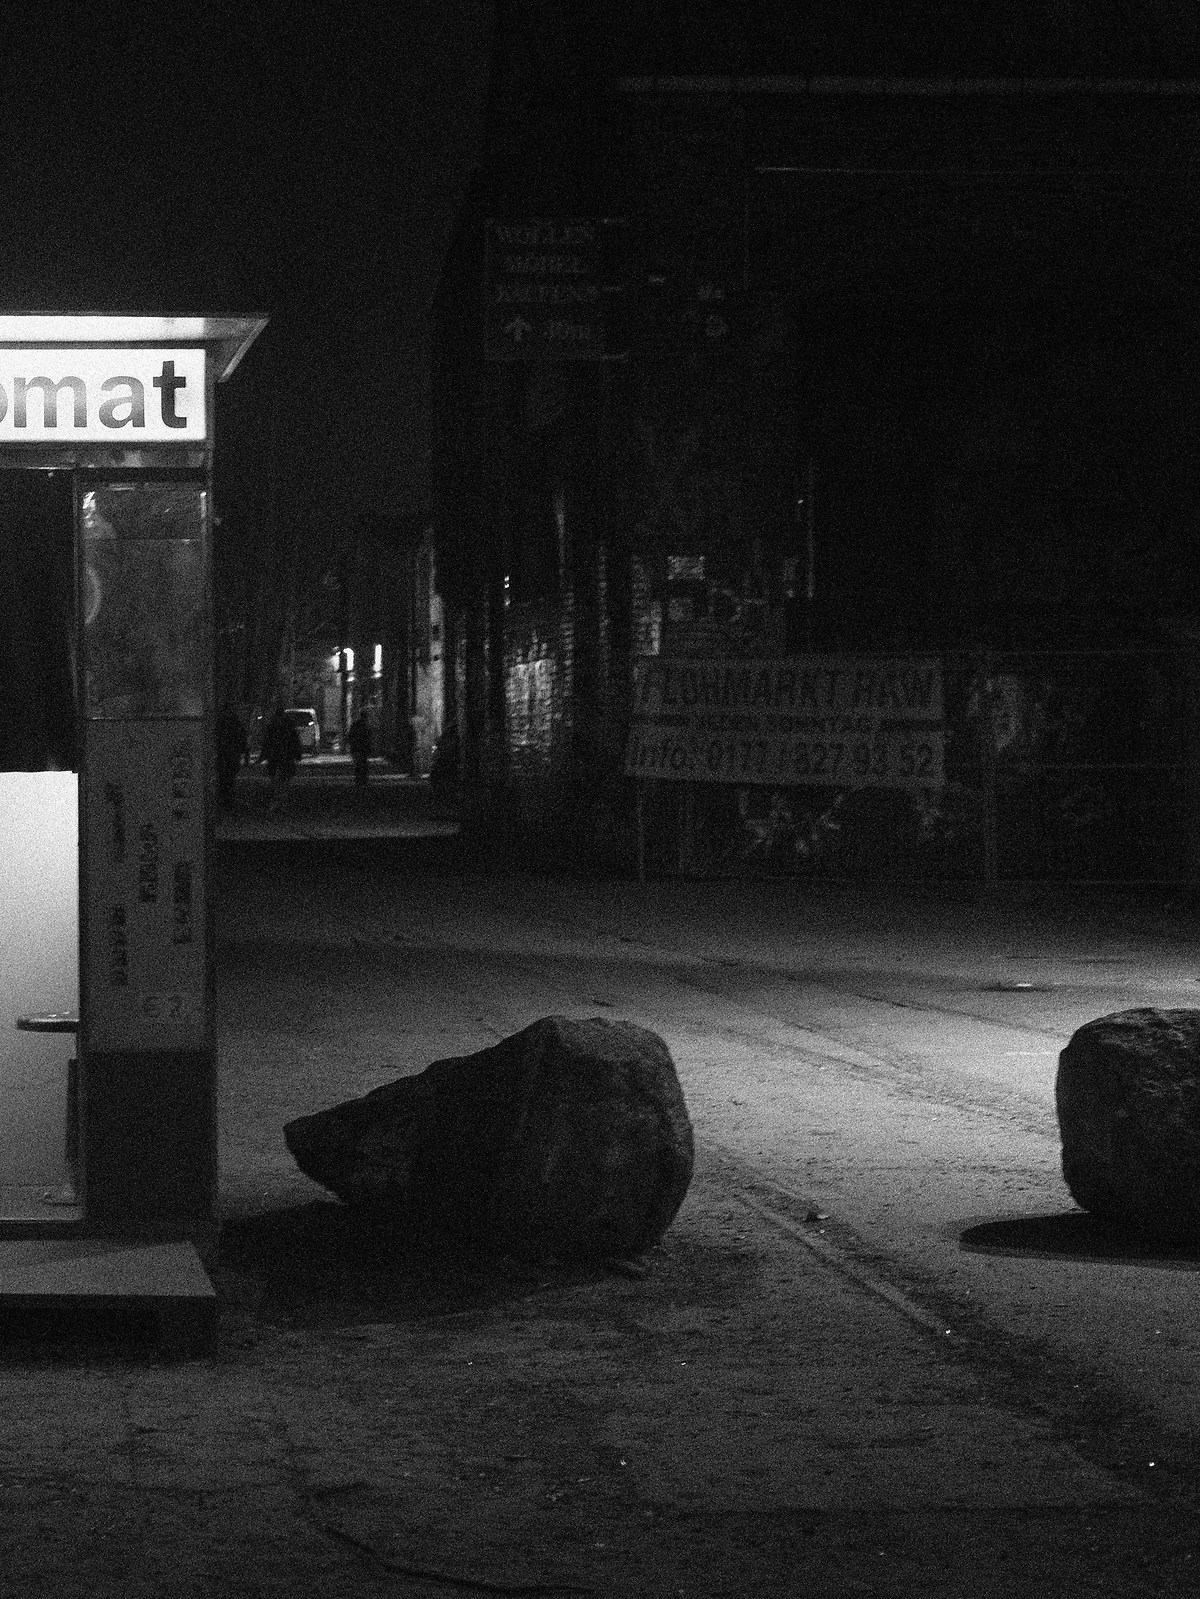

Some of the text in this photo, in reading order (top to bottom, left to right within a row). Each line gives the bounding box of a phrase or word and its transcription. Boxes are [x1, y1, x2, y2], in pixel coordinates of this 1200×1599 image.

[642, 666, 844, 708] FLOHMARKT
[705, 738, 769, 774] 0177
[852, 742, 889, 778] 93
[898, 742, 935, 778] 52
